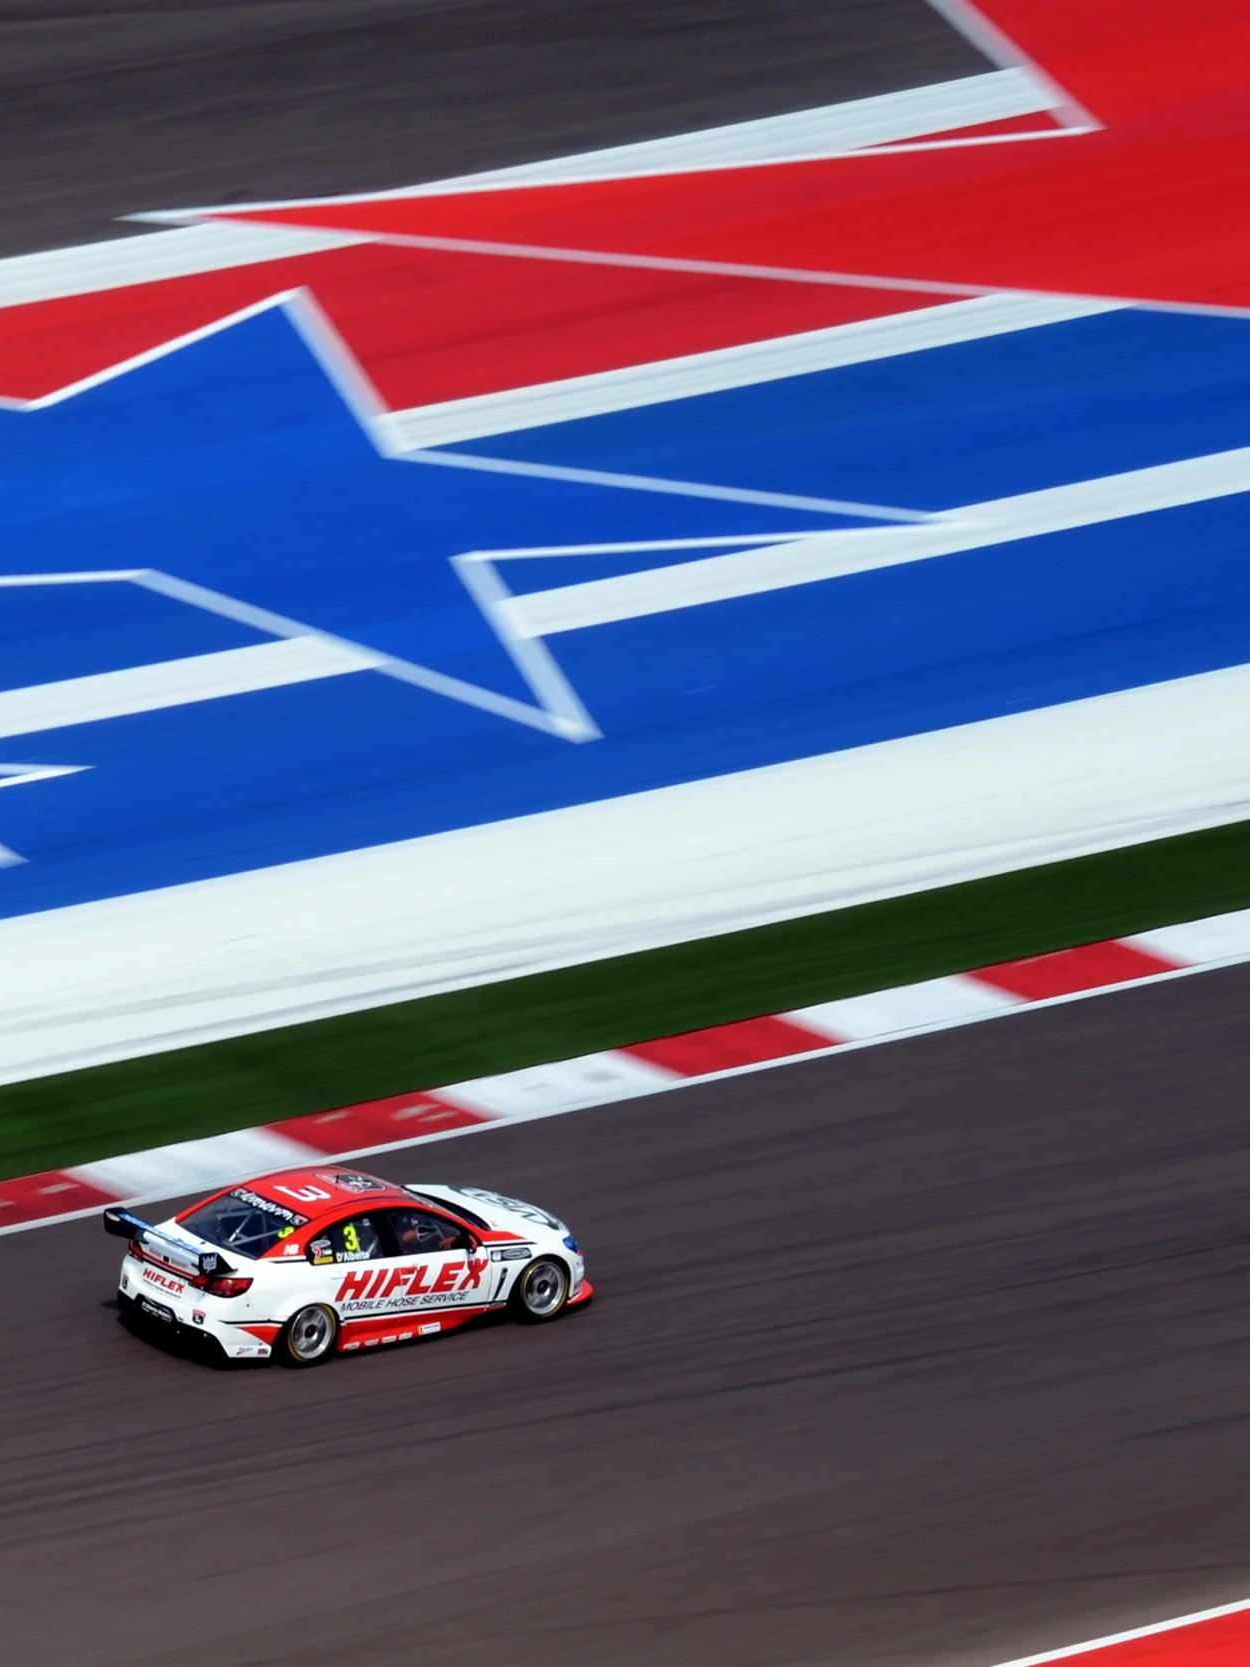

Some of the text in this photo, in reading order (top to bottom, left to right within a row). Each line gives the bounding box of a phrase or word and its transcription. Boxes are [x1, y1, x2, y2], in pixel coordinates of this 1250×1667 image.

[273, 1185, 331, 1202] 3
[343, 1225, 359, 1251] 3
[335, 1251, 370, 1263] D'Alberto
[143, 1268, 186, 1294] HIFLEX
[335, 1258, 489, 1302] HIFLEX
[340, 1291, 470, 1312] MOBILE HOSE SERVICE
